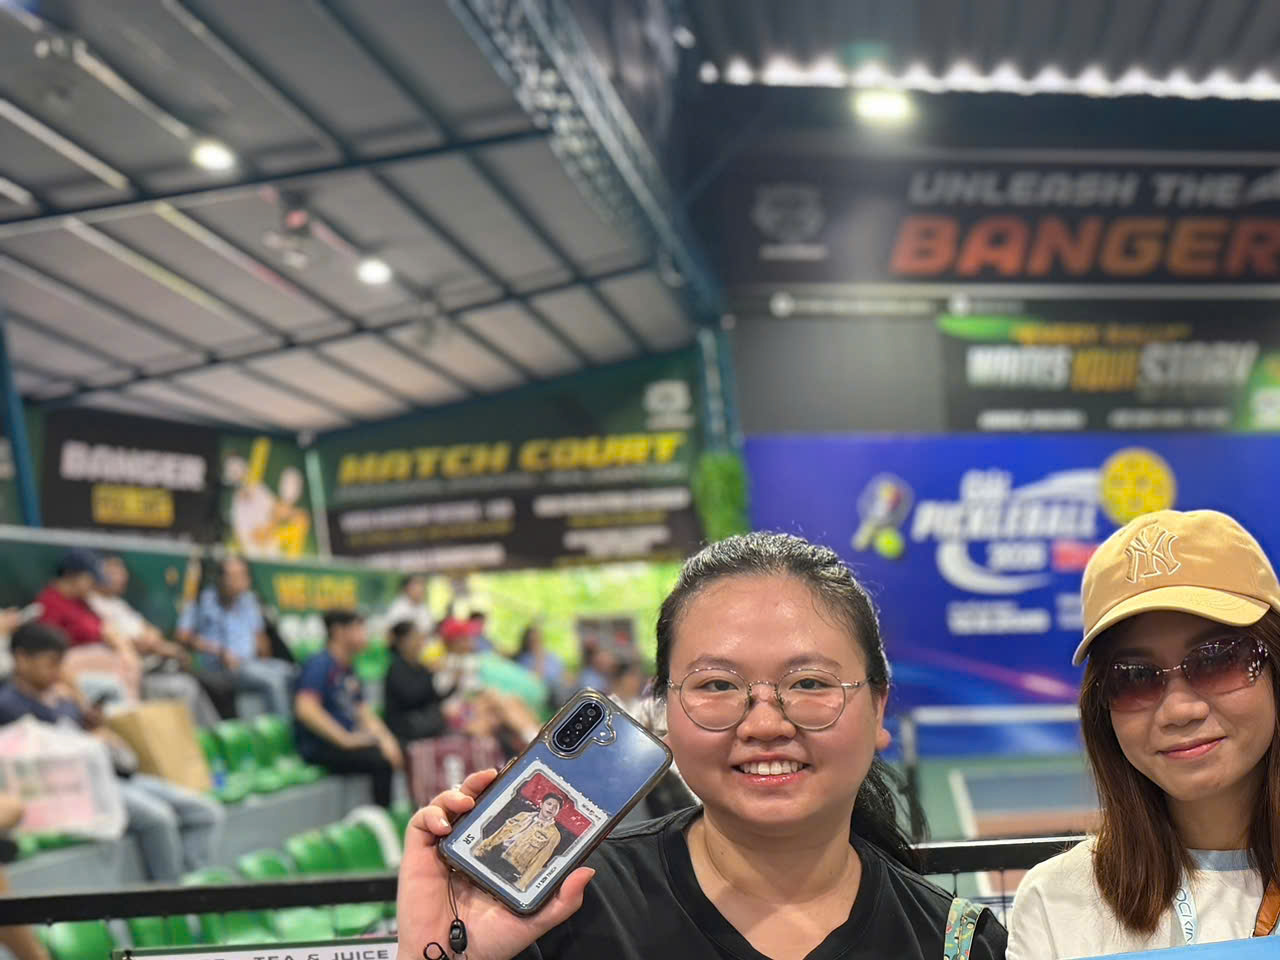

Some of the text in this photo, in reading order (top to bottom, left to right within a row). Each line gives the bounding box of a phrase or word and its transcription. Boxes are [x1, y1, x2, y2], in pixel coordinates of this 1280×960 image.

[907, 170, 1246, 206] UNLEASH THE
[338, 441, 512, 487] MATCH
[517, 430, 688, 473] COURT
[1124, 520, 1182, 583] NY
